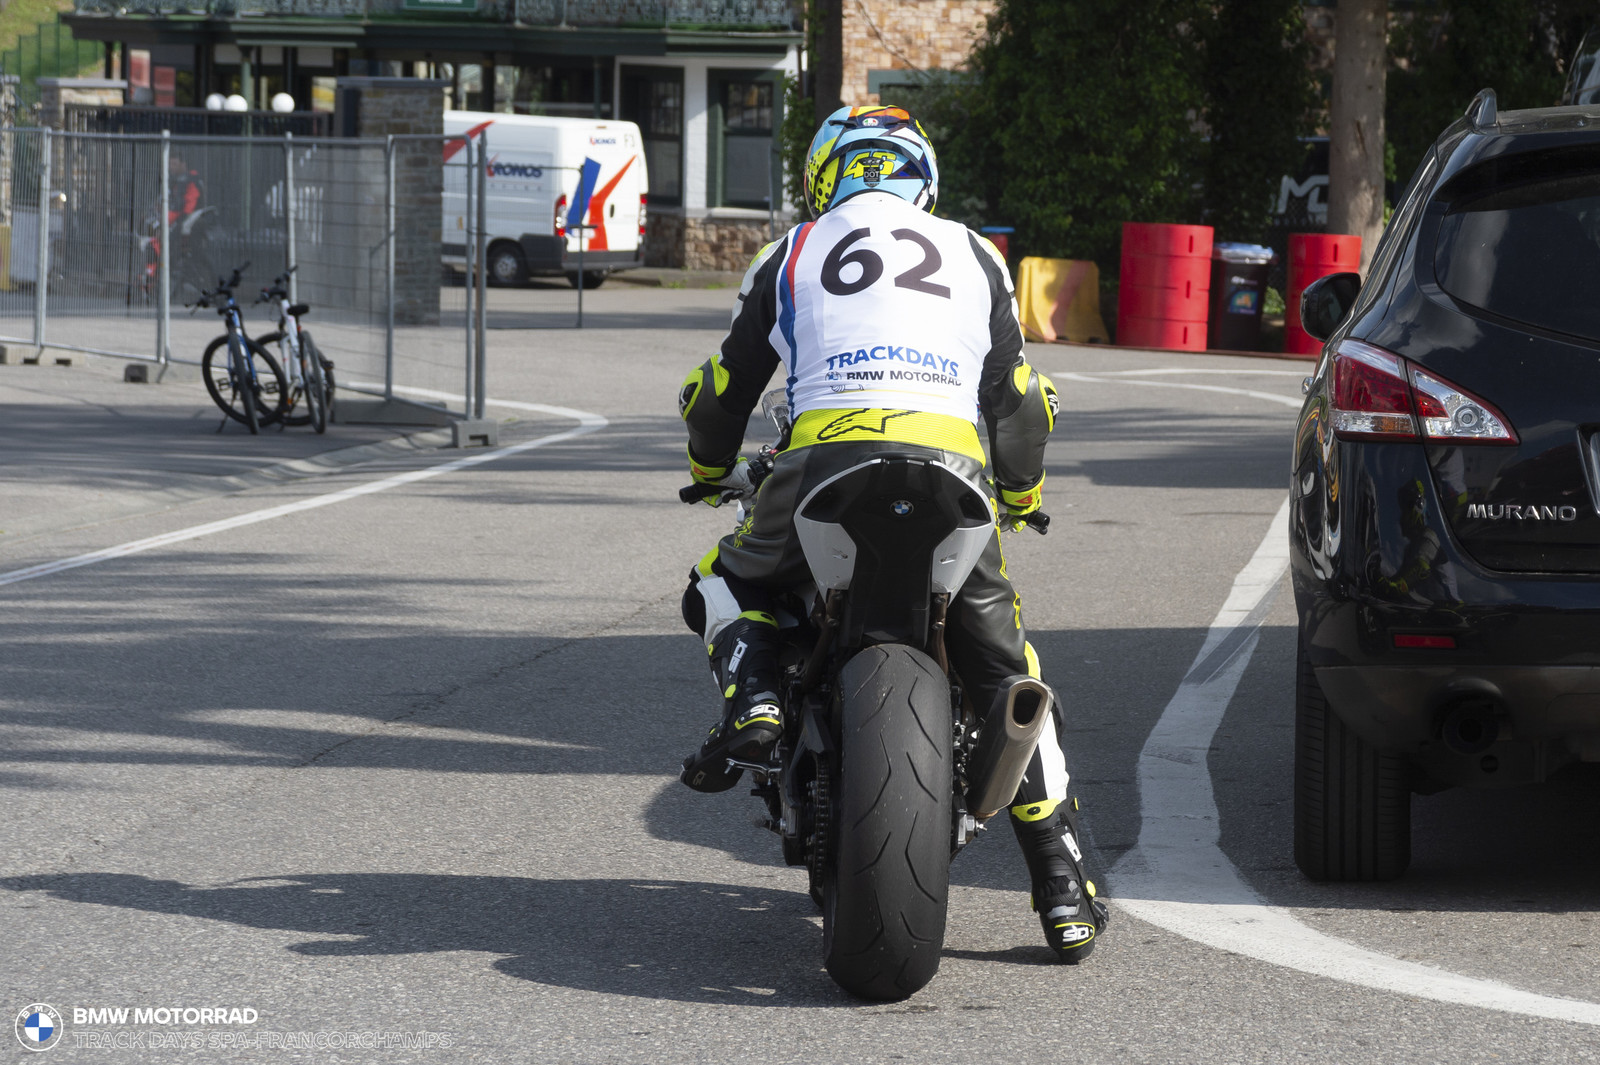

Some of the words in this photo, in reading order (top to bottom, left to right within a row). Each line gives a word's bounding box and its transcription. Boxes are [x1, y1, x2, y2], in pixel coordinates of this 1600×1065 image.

[820, 227, 950, 299] 62
[825, 345, 959, 377] TRACKDAYS
[846, 370, 884, 380] BMW
[1467, 504, 1577, 521] MURANO
